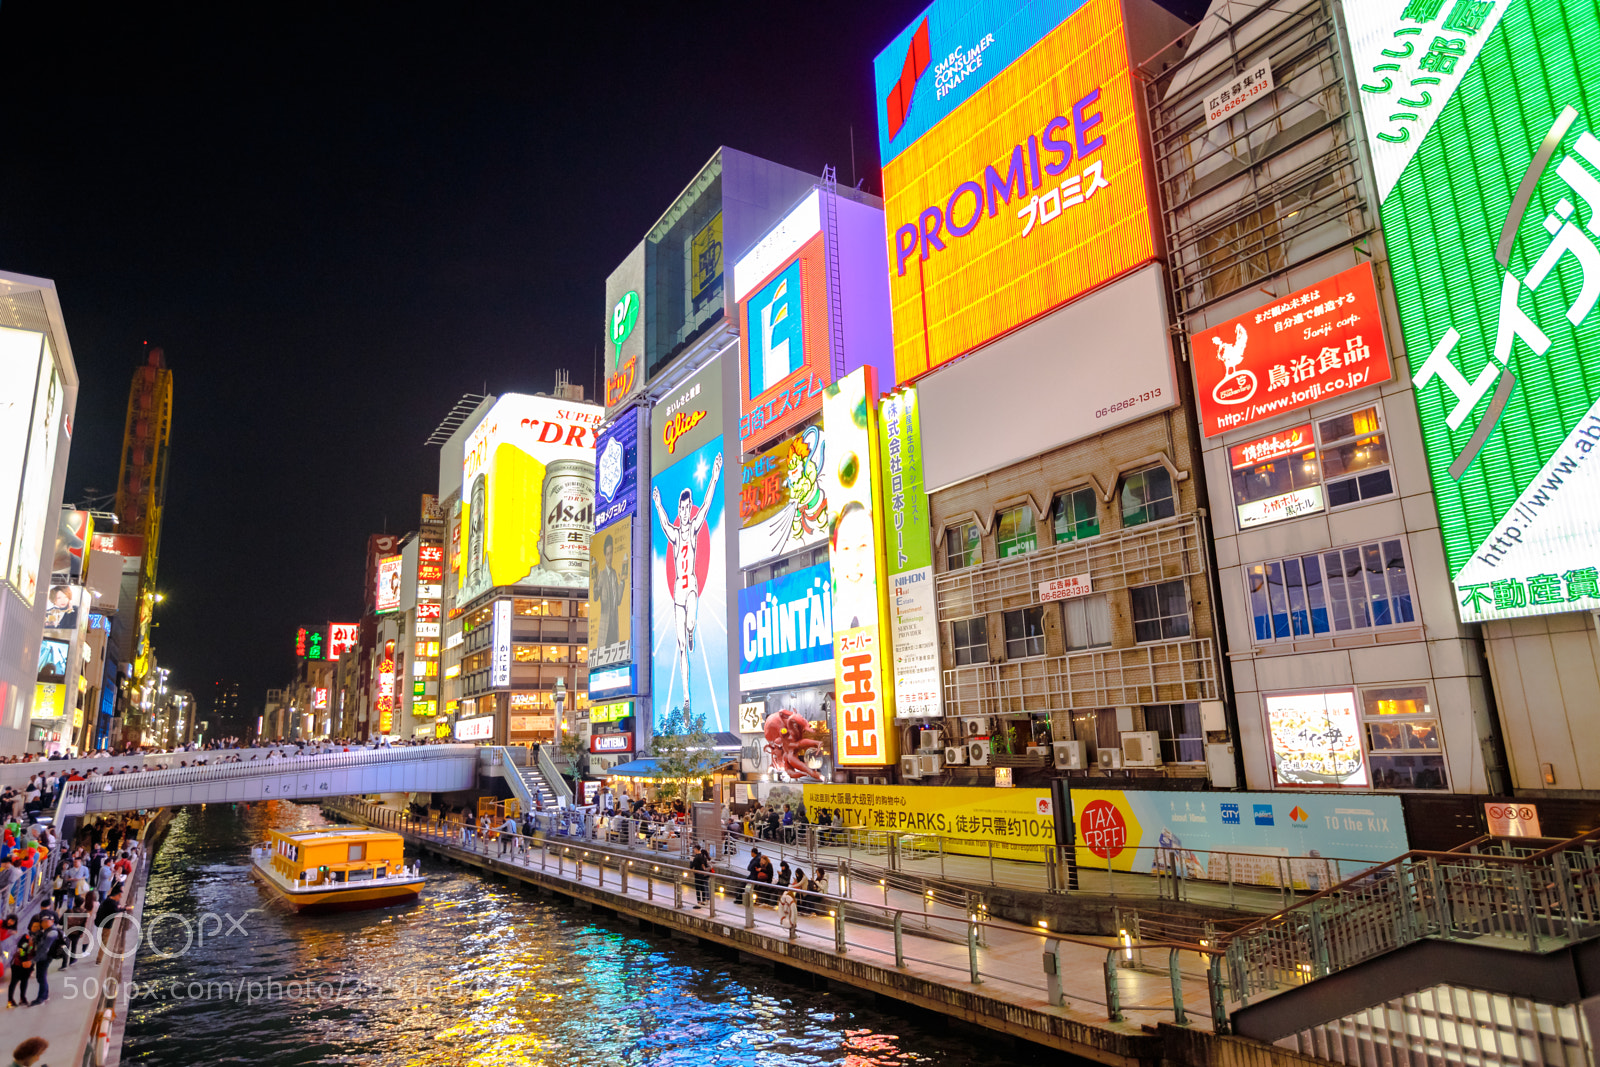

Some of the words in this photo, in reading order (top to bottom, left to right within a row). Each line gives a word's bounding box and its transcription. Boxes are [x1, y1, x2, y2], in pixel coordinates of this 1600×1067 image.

[935, 33, 995, 89] CONSUMER
[935, 45, 962, 78] SMBC
[936, 55, 983, 101] FINANCE
[1208, 67, 1267, 111] 広告募集中
[1210, 80, 1269, 121] 06-6262-1313
[895, 87, 1106, 278] PROMISE
[1017, 159, 1110, 238] プロミス
[606, 355, 637, 408] ピップ
[1267, 335, 1371, 392] 鳥治食品
[556, 409, 602, 425] SUPER
[738, 372, 824, 441] 日商エステム
[1095, 388, 1161, 418] 06-6262-1313
[1217, 366, 1370, 429] http://www.toriji.co.jp/
[663, 409, 706, 454] Glico
[741, 454, 776, 484] かぜに
[888, 402, 907, 568] 株式会社日本リート
[738, 471, 781, 518] 改源
[567, 532, 583, 542] 生
[681, 542, 689, 590] グリコ
[895, 572, 925, 587] NIHON
[1050, 578, 1079, 590] 広告募集
[1041, 585, 1090, 601] 06-6262-1313
[743, 577, 833, 663] CHINTAI
[841, 635, 872, 651] スーパー
[842, 654, 877, 756] 玉出
[601, 737, 625, 749] LOTTERIA
[1085, 805, 1116, 829] TAX
[1221, 810, 1239, 818] CITY
[1325, 816, 1339, 830] TO
[1343, 817, 1363, 831] the
[1368, 818, 1389, 833] KIX
